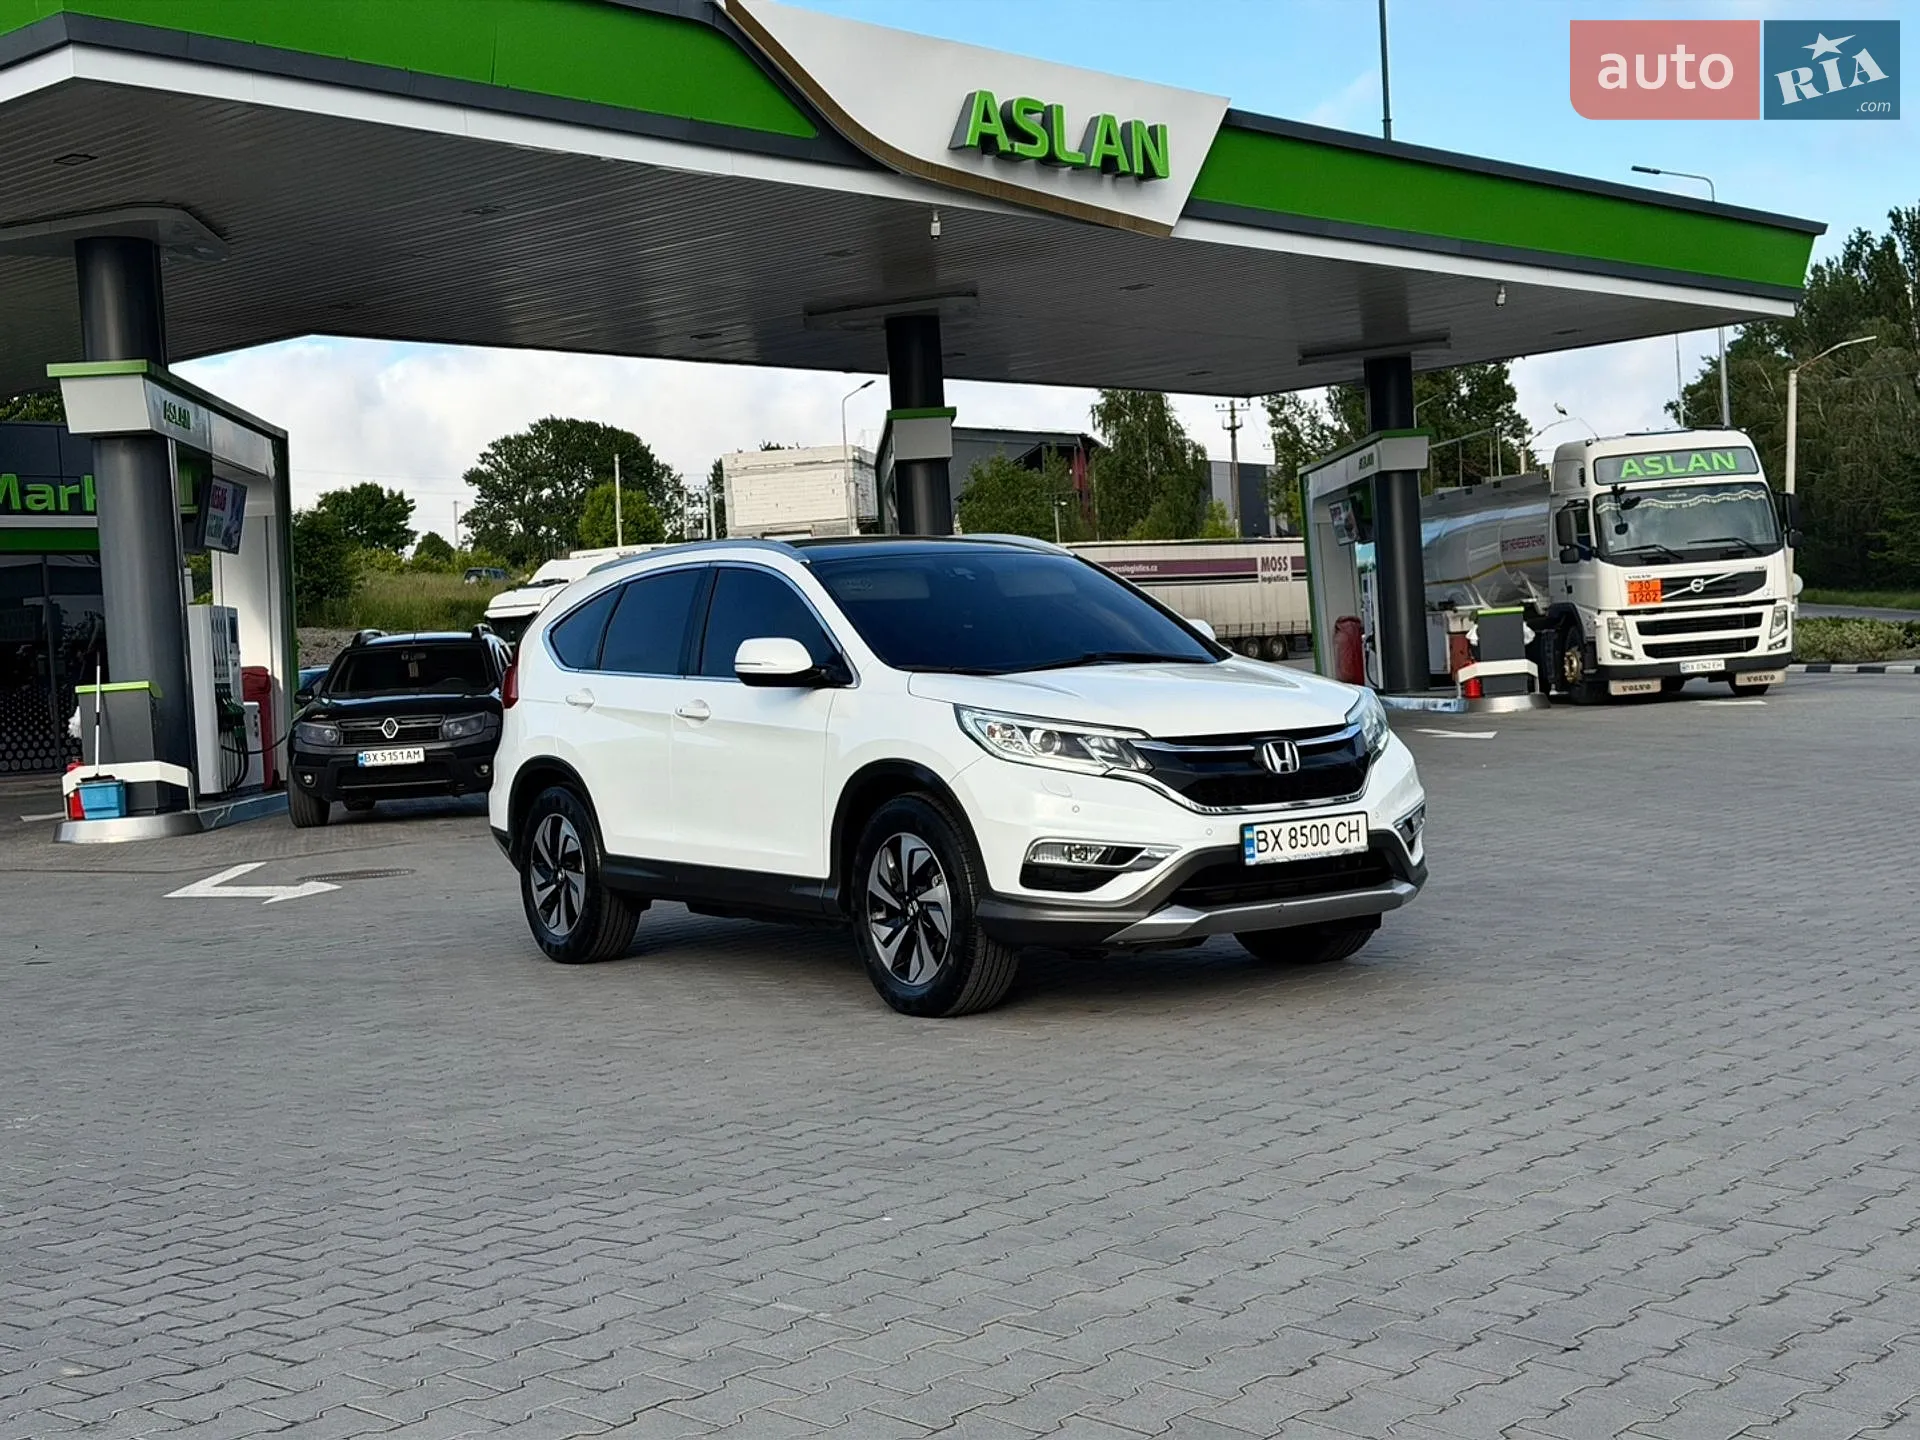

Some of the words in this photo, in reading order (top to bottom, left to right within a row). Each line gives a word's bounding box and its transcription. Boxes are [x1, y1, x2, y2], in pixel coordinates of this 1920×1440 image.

[953, 88, 1170, 181] ASLAN
[1620, 451, 1737, 479] ASLAN
[1261, 556, 1288, 572] MOSS
[1633, 590, 1659, 603] 1202
[1747, 674, 1776, 683] VOLVO
[1622, 684, 1652, 692] VOLVO
[364, 753, 378, 763] BX
[381, 751, 404, 762] 5151
[406, 750, 420, 760] AM
[1256, 828, 1283, 854] BX
[1288, 823, 1330, 849] 8500
[1335, 819, 1360, 844] CH
